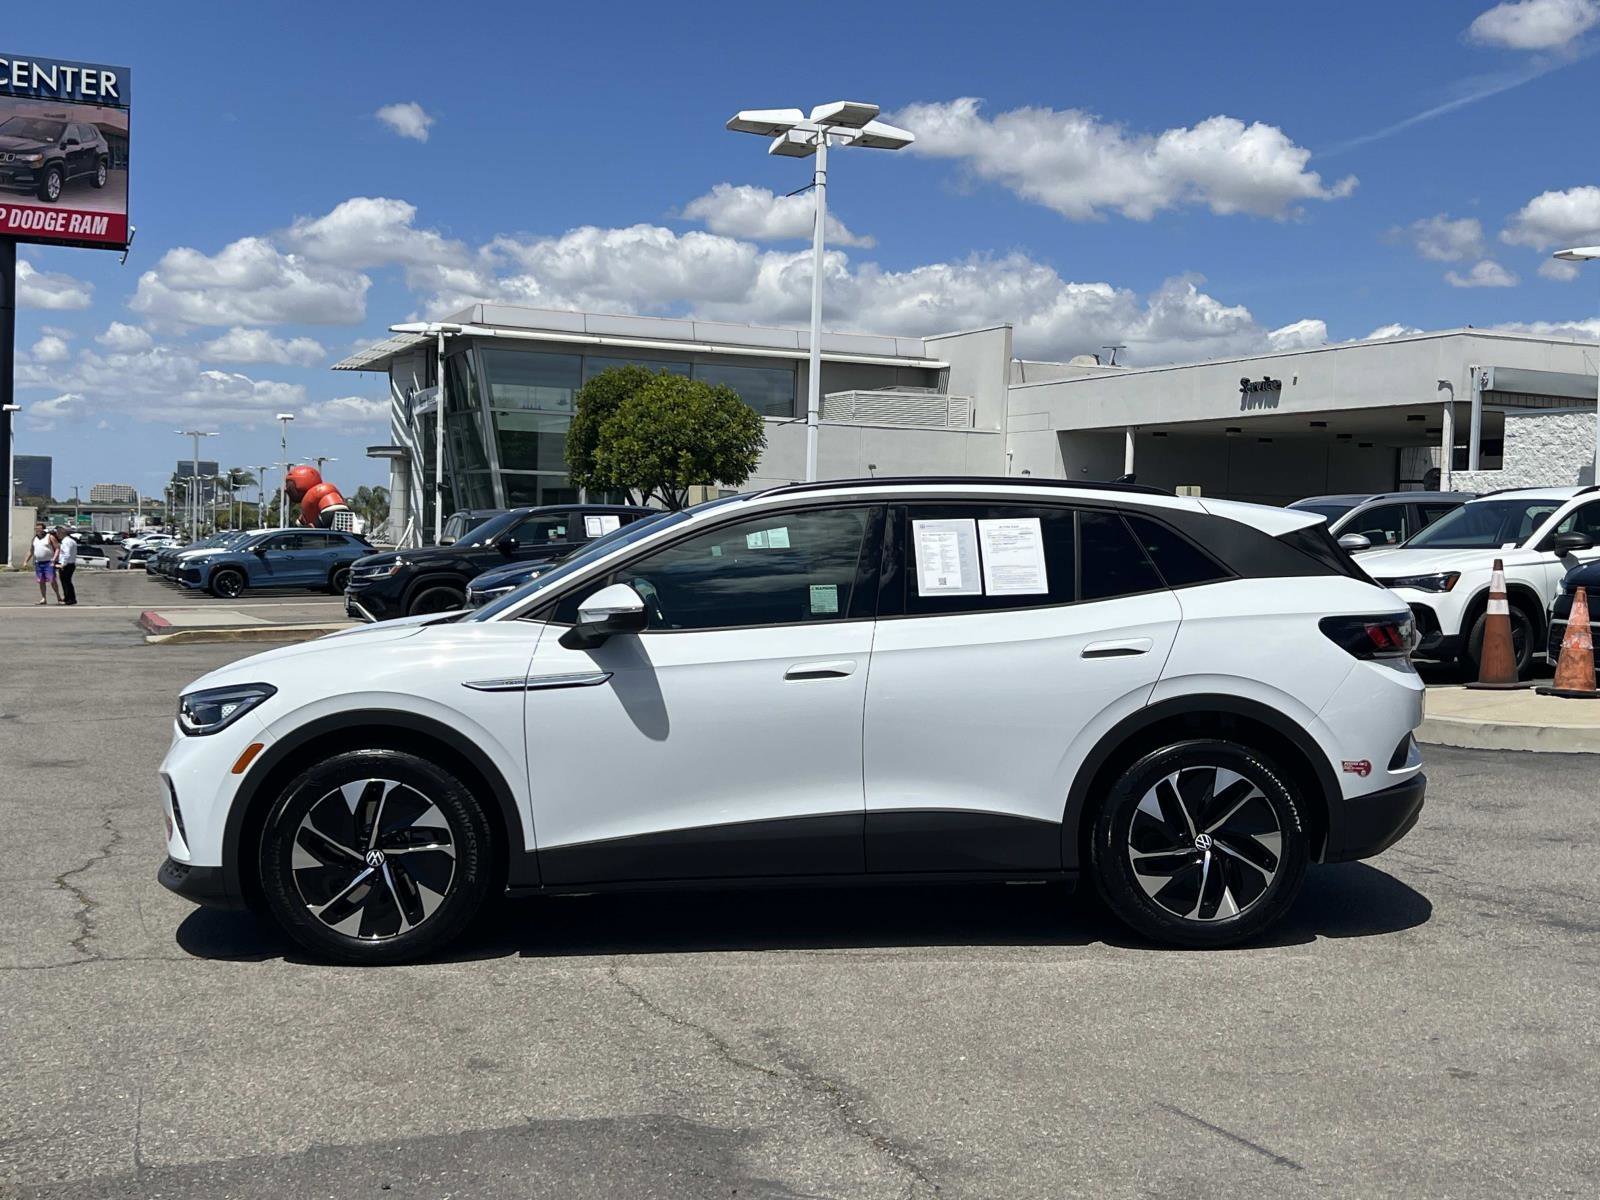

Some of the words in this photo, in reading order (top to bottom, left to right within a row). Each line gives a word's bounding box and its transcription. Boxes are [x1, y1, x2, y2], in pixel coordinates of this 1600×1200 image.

[8, 208, 68, 232] DODGE
[68, 213, 110, 235] RAM
[1239, 376, 1281, 392] Service
